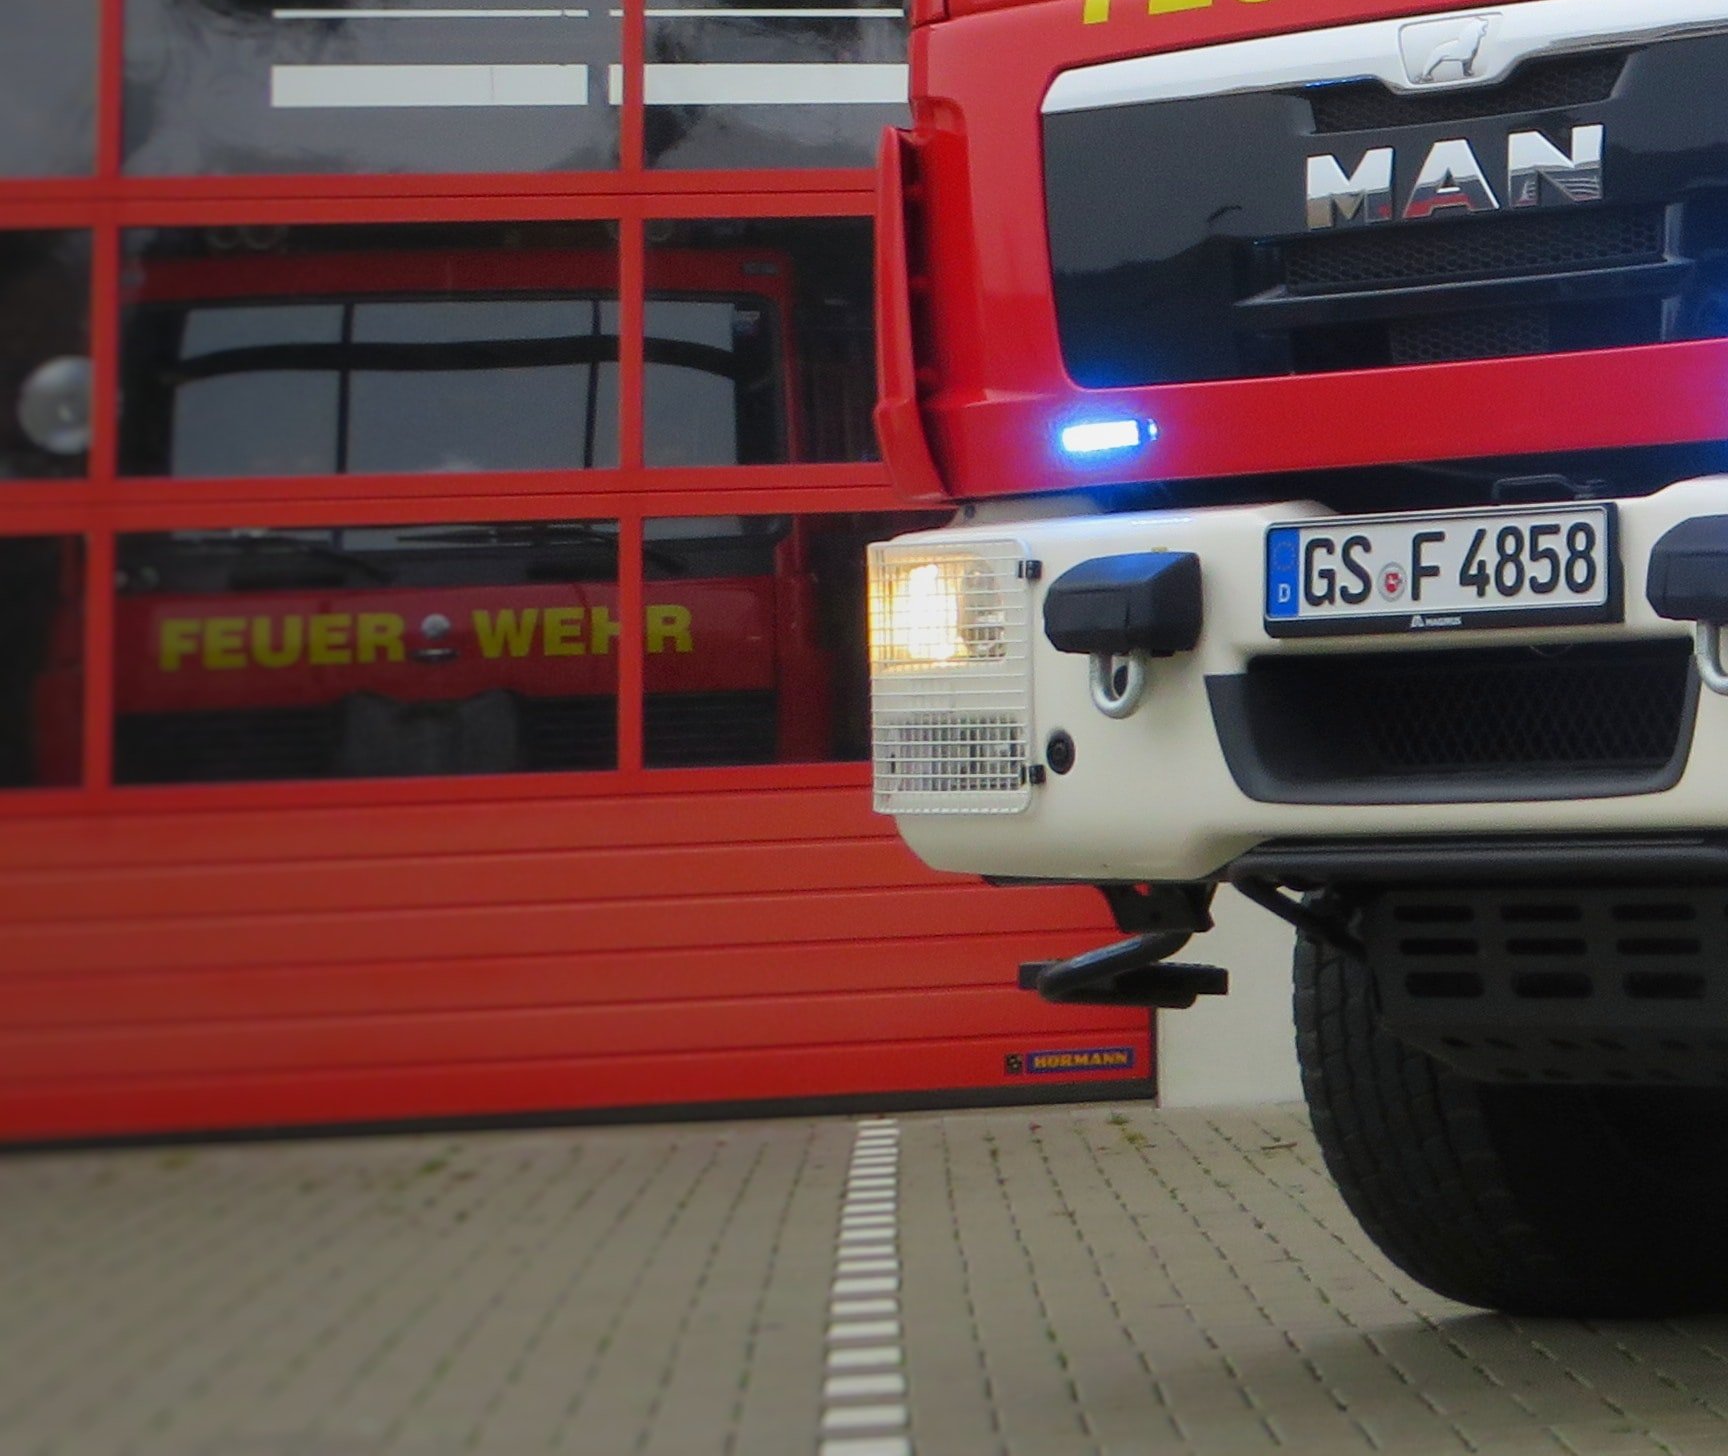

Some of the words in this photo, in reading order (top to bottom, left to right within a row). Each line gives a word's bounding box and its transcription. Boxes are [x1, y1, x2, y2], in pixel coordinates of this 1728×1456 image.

[1306, 124, 1604, 231] MAN
[1277, 582, 1291, 604] D
[1303, 535, 1373, 607] GS
[1411, 530, 1446, 602] F
[1459, 521, 1597, 598] 4858
[159, 611, 407, 672] FEUER
